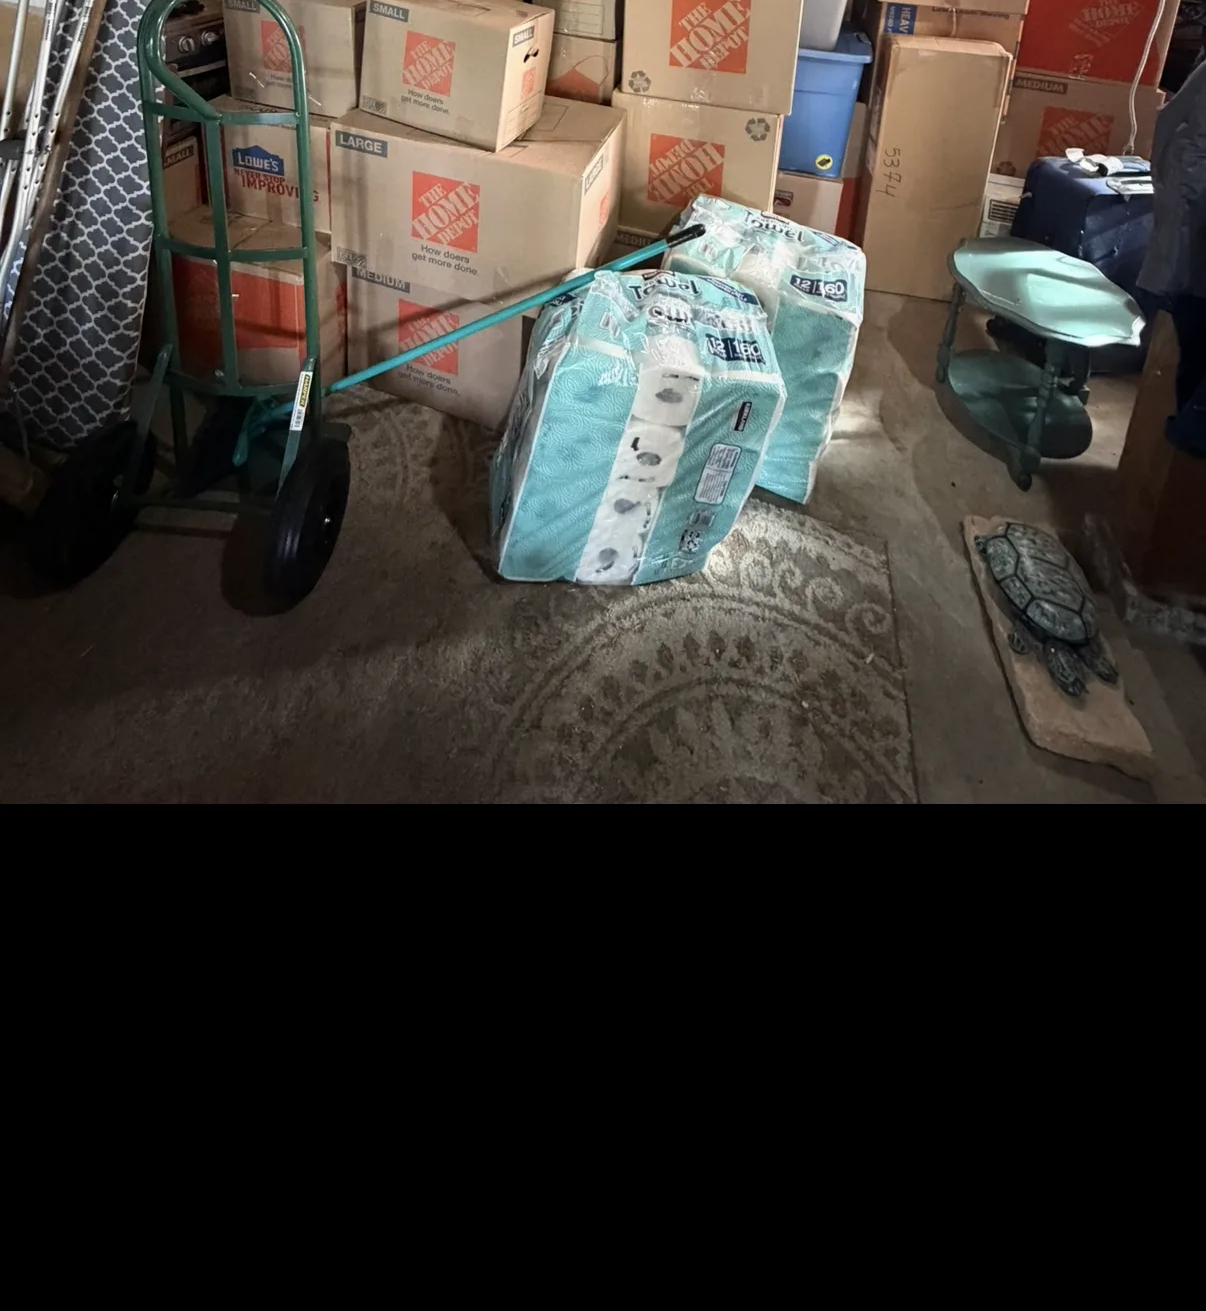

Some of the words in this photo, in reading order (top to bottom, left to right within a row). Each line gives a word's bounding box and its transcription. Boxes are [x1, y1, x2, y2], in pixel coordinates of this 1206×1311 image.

[373, 2, 406, 20] SMALL
[678, 2, 713, 31] THE
[1082, 2, 1139, 22] HOME
[515, 28, 534, 45] SMALL
[410, 40, 430, 60] THE
[700, 26, 750, 70] DEPOT
[403, 41, 456, 86] HOME
[420, 62, 454, 89] DEPOT
[1016, 79, 1065, 93] MEDIUM
[400, 95, 413, 105] get
[414, 97, 430, 109] more
[407, 89, 423, 99] How
[424, 93, 444, 105] doers
[339, 134, 382, 154] LARGE
[163, 146, 193, 167] MALL
[238, 152, 279, 173] LOWE'S
[649, 138, 696, 178] DEPOT
[263, 173, 285, 184] STOP
[650, 141, 724, 204] HOME
[875, 146, 902, 198] 5374
[241, 175, 319, 202] IMPROVIG
[418, 182, 447, 208] THE
[412, 181, 480, 240] HOME
[437, 209, 480, 246] DEPOT
[744, 209, 804, 242] Towel
[411, 251, 426, 264] get
[428, 256, 452, 269] more
[421, 244, 442, 256] How
[444, 248, 470, 264] doers
[356, 268, 406, 290] MEDIUM
[794, 276, 812, 289] 12
[398, 371, 412, 382] get
[414, 375, 434, 387] more
[406, 364, 425, 377] How
[426, 371, 451, 384] doers
[300, 375, 310, 406] HARPER
